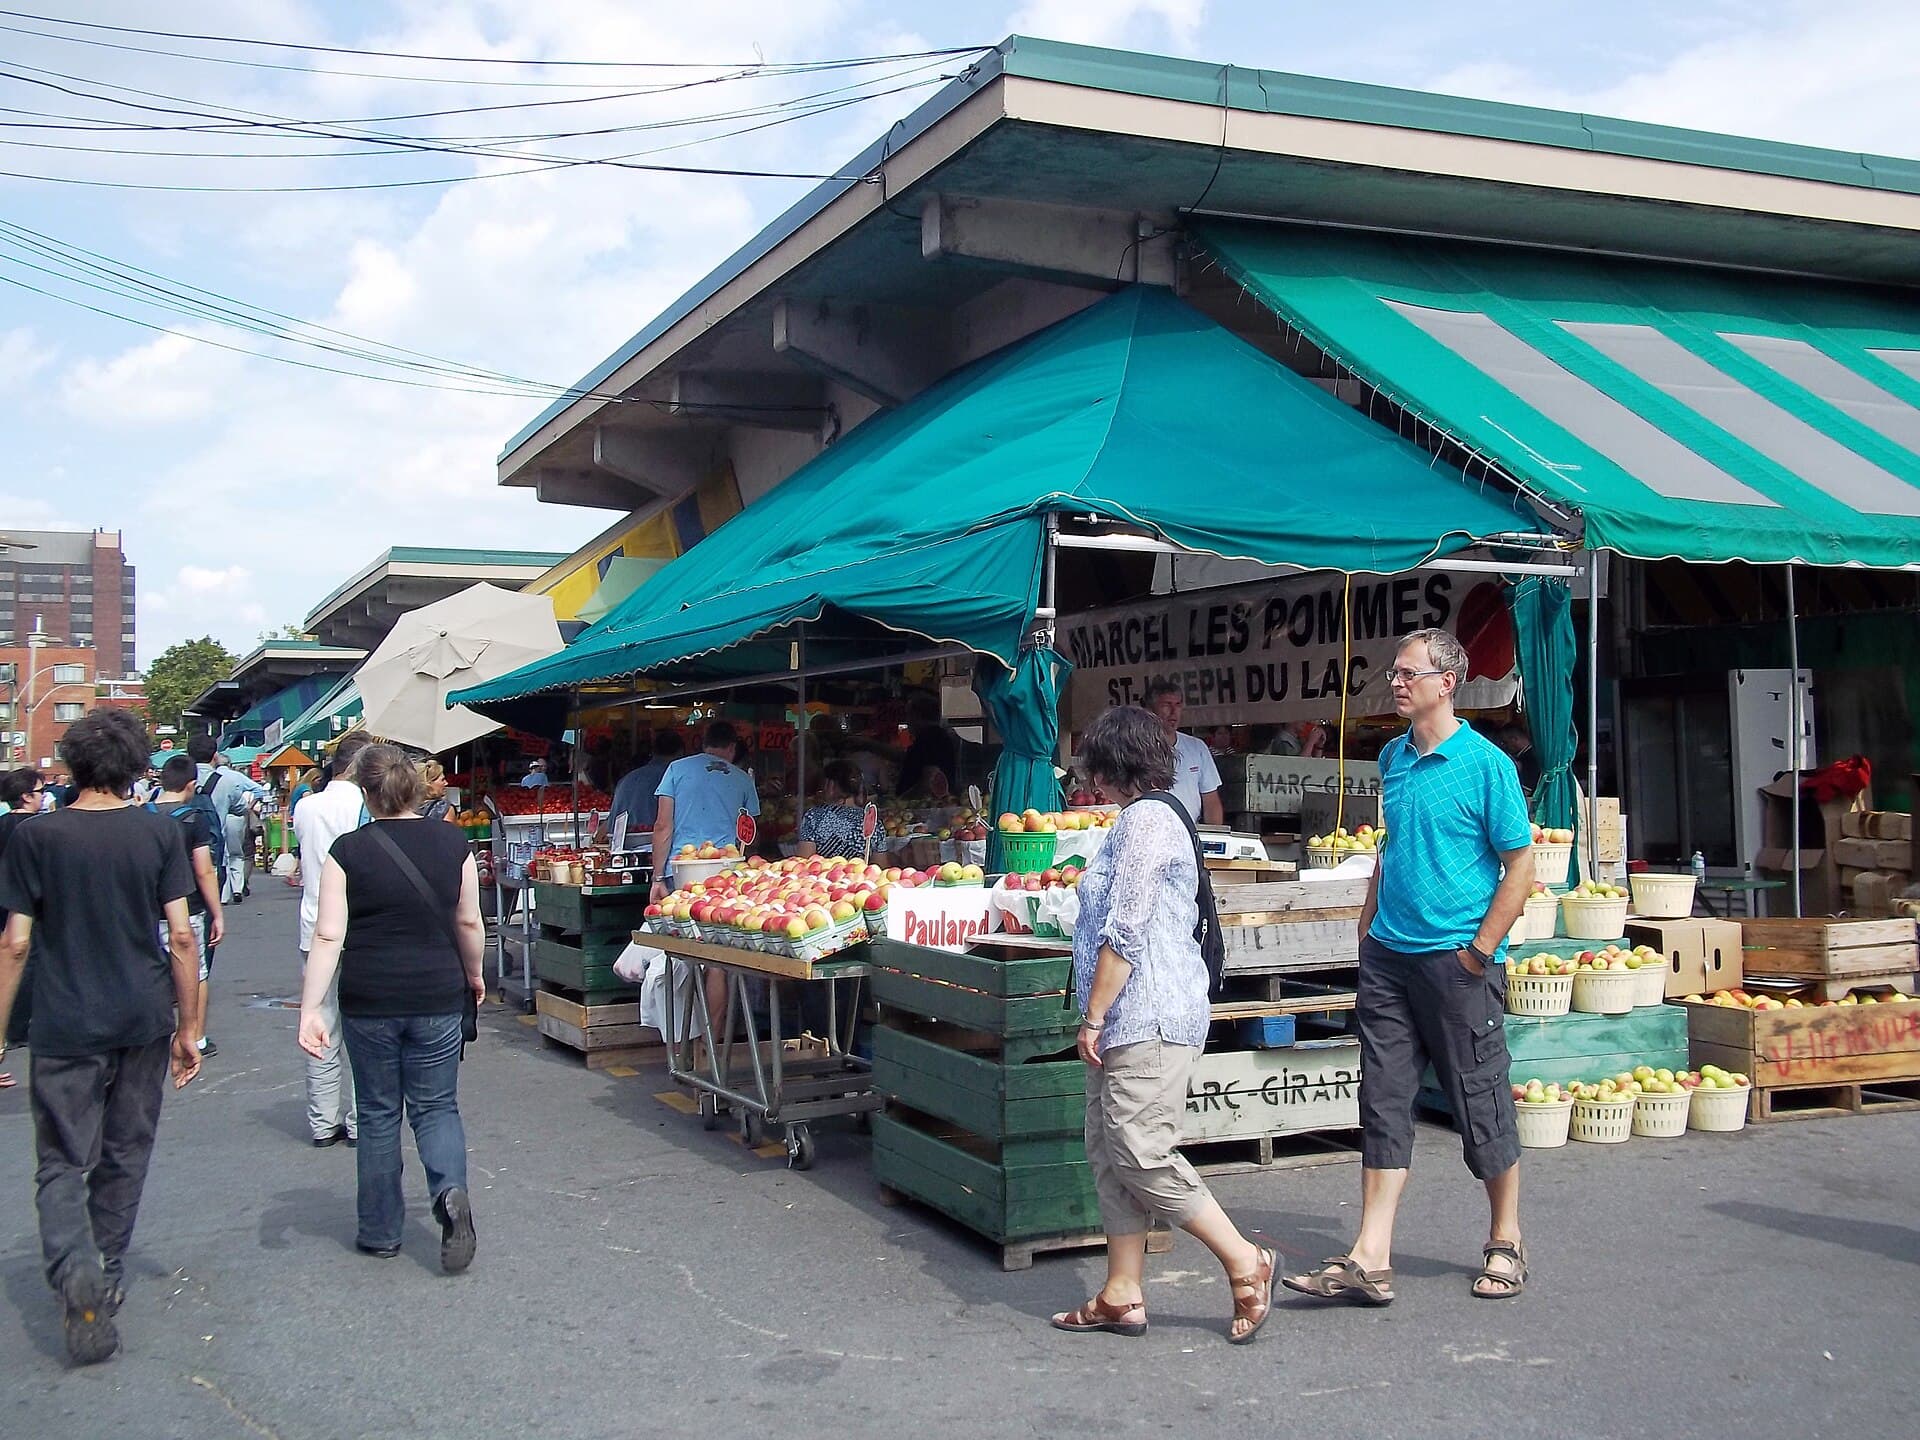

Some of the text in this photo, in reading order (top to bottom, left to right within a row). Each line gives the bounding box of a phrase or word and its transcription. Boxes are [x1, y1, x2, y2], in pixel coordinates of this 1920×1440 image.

[1068, 573, 1452, 669] MARCEL LES POMMES
[1108, 655, 1369, 706] ST-JEPH DU LAC
[904, 909, 990, 947] Paulared
[1185, 1075, 1241, 1113] ARC
[1260, 1067, 1362, 1106] GIRAR
